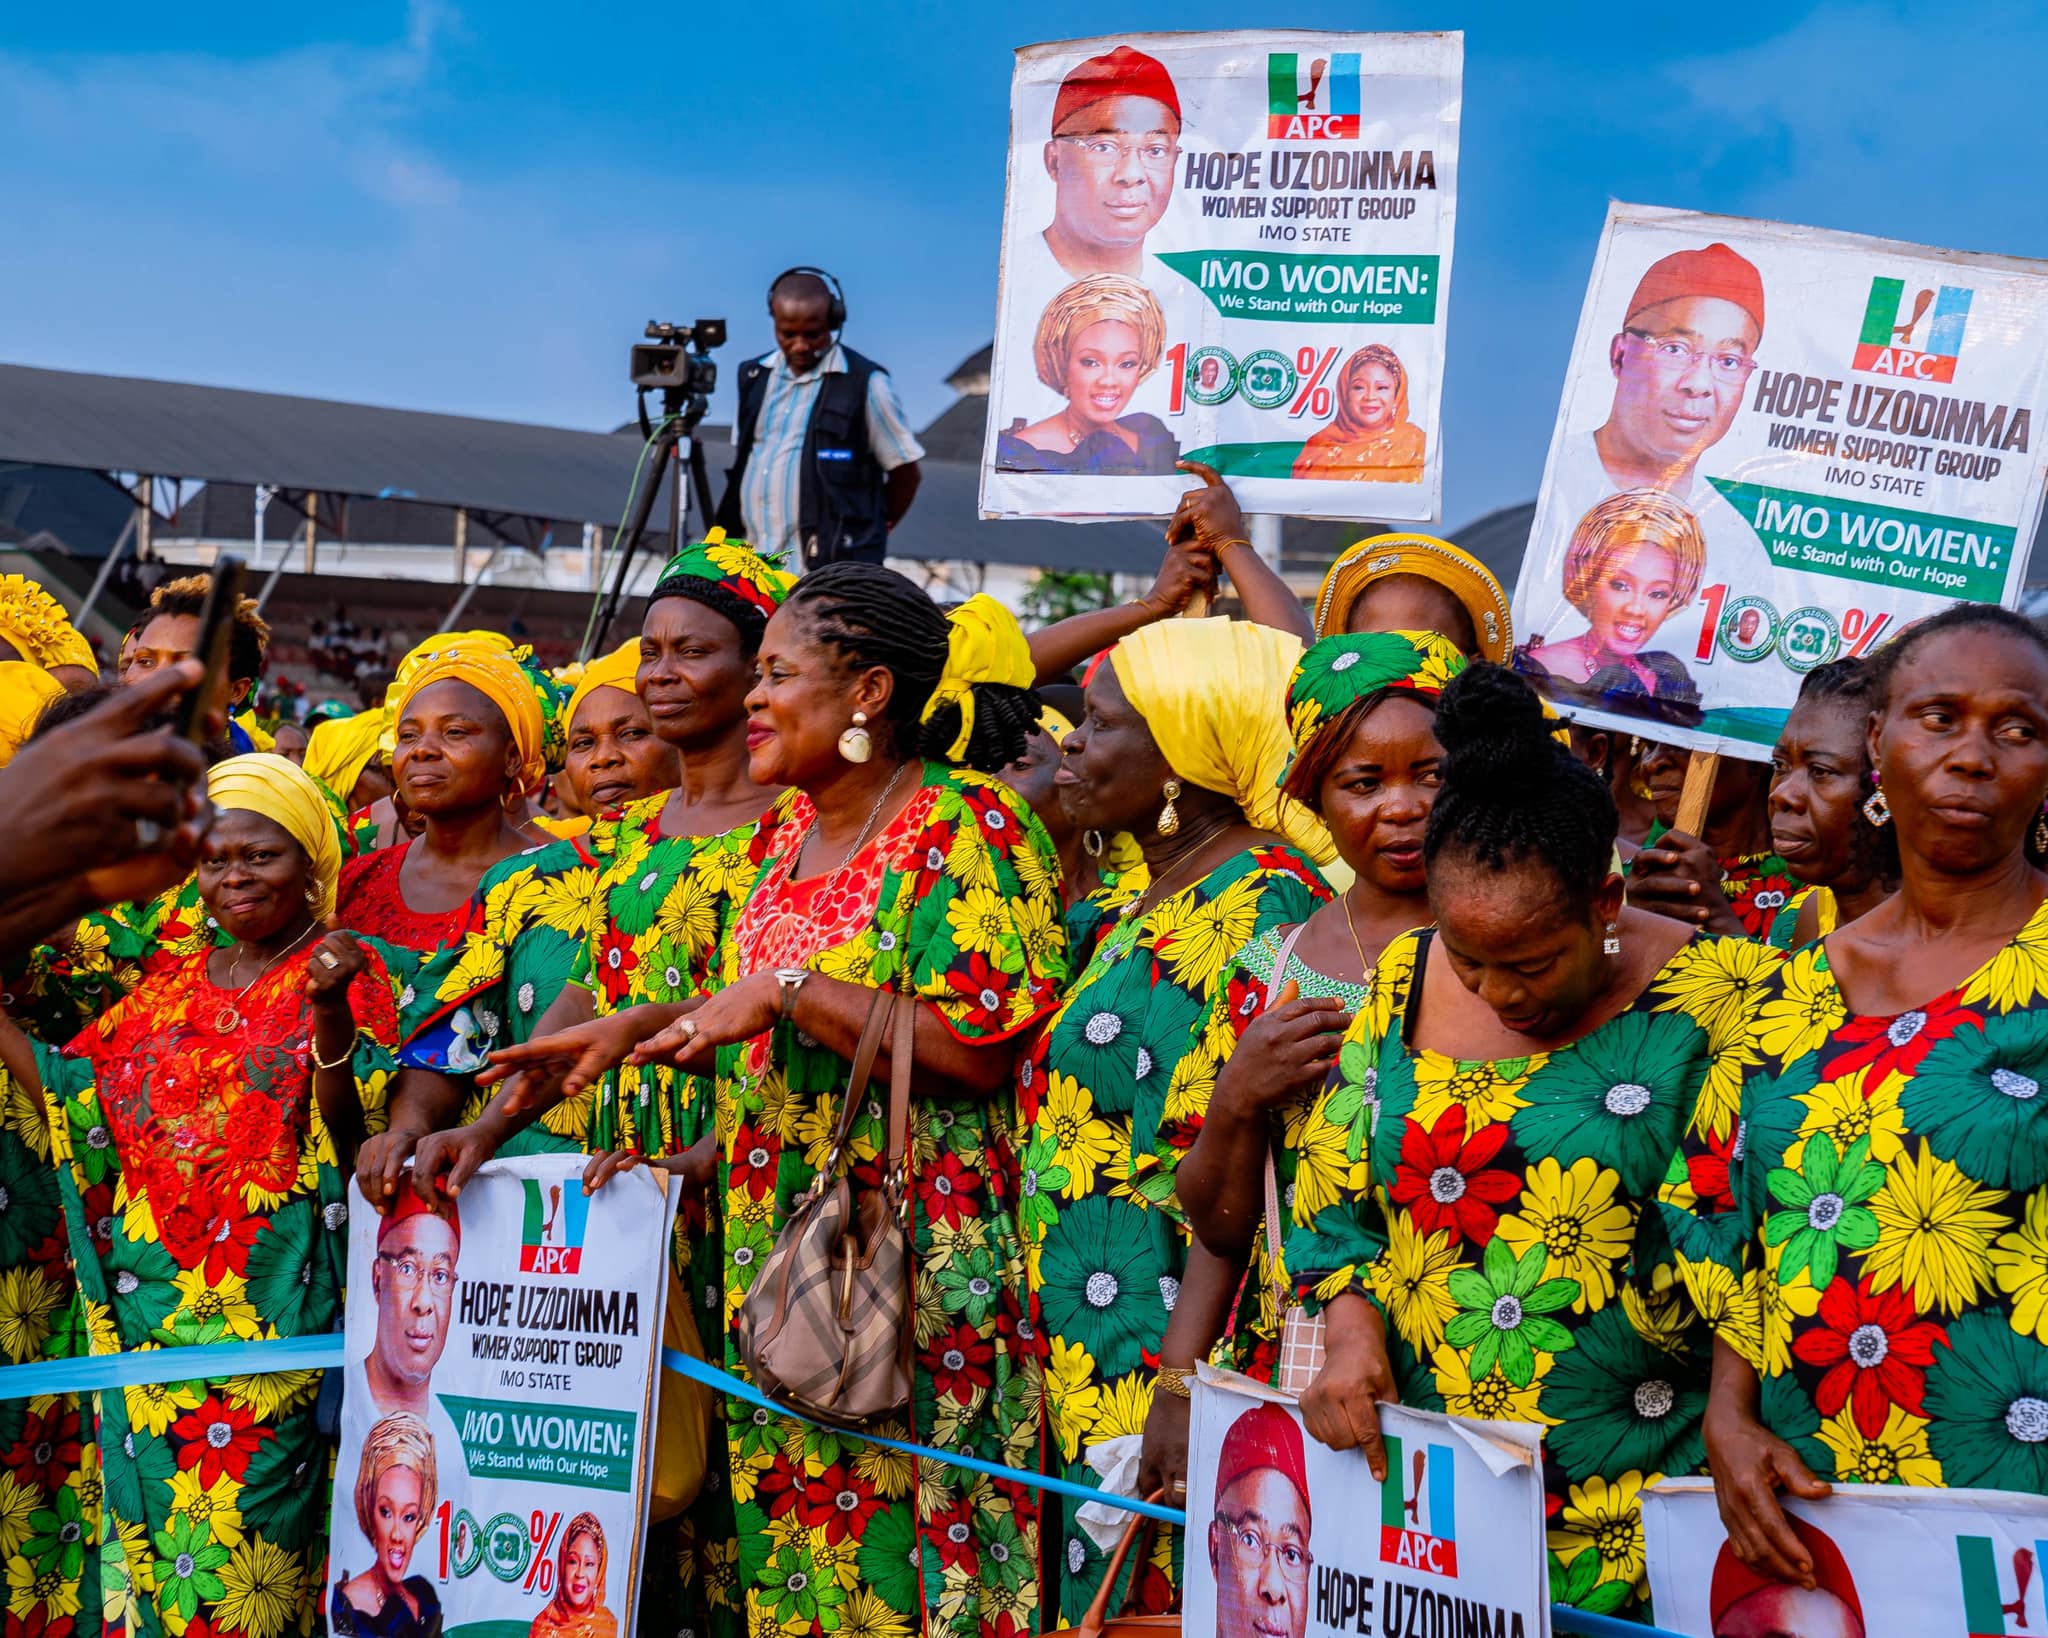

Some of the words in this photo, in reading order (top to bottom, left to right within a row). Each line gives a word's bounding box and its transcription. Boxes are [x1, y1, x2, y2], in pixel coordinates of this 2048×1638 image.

[1284, 115, 1343, 139] APC
[1184, 151, 1261, 190] HOPE
[1270, 150, 1437, 191] UZODINMA
[1201, 196, 1266, 218] WOMEN
[1271, 196, 1354, 219] SUPPORT
[1358, 197, 1416, 220] GROUP
[1259, 225, 1297, 241] IMO
[1302, 227, 1352, 242] STATE
[1200, 260, 1270, 291] IMO
[1279, 264, 1429, 296] WOMEN:
[1218, 294, 1244, 309] We
[1248, 296, 1291, 312] Stand
[1294, 299, 1328, 313] with
[1331, 300, 1359, 314] Our
[1363, 301, 1403, 317] Hope
[1871, 348, 1937, 380] APC
[1753, 370, 1843, 423] HOPE
[1846, 383, 2031, 454] UZODINMA
[1768, 423, 1839, 457] WOMEN
[1841, 434, 1933, 472] SUPPORT
[1934, 449, 2002, 482] GROUP
[1825, 466, 1865, 487] IMO
[1870, 474, 1925, 497] STATE
[1754, 498, 1829, 539] IMO
[1840, 511, 2001, 570] WOMEN:
[1772, 539, 1797, 557] We
[1801, 544, 1847, 567] Stand
[1850, 553, 1885, 575] with
[1888, 560, 1920, 582] Our
[1923, 565, 1967, 588] Hope
[531, 1247, 571, 1274] APC
[459, 1281, 514, 1327] HOPE
[516, 1285, 639, 1337] UZODINMA
[472, 1333, 512, 1360] WOMEN
[511, 1336, 570, 1365] SUPPORT
[575, 1341, 623, 1369] GROUP
[500, 1369, 525, 1387] IMO
[528, 1372, 571, 1391] STATE
[462, 1410, 504, 1444] IMO
[511, 1414, 628, 1457] WOMEN:
[469, 1450, 486, 1466] We
[487, 1452, 524, 1469] Stand
[527, 1456, 554, 1471] with
[557, 1458, 577, 1473] Our
[580, 1462, 609, 1480] Hope
[1396, 1531, 1444, 1575] APC
[1316, 1565, 1374, 1637] HOPE
